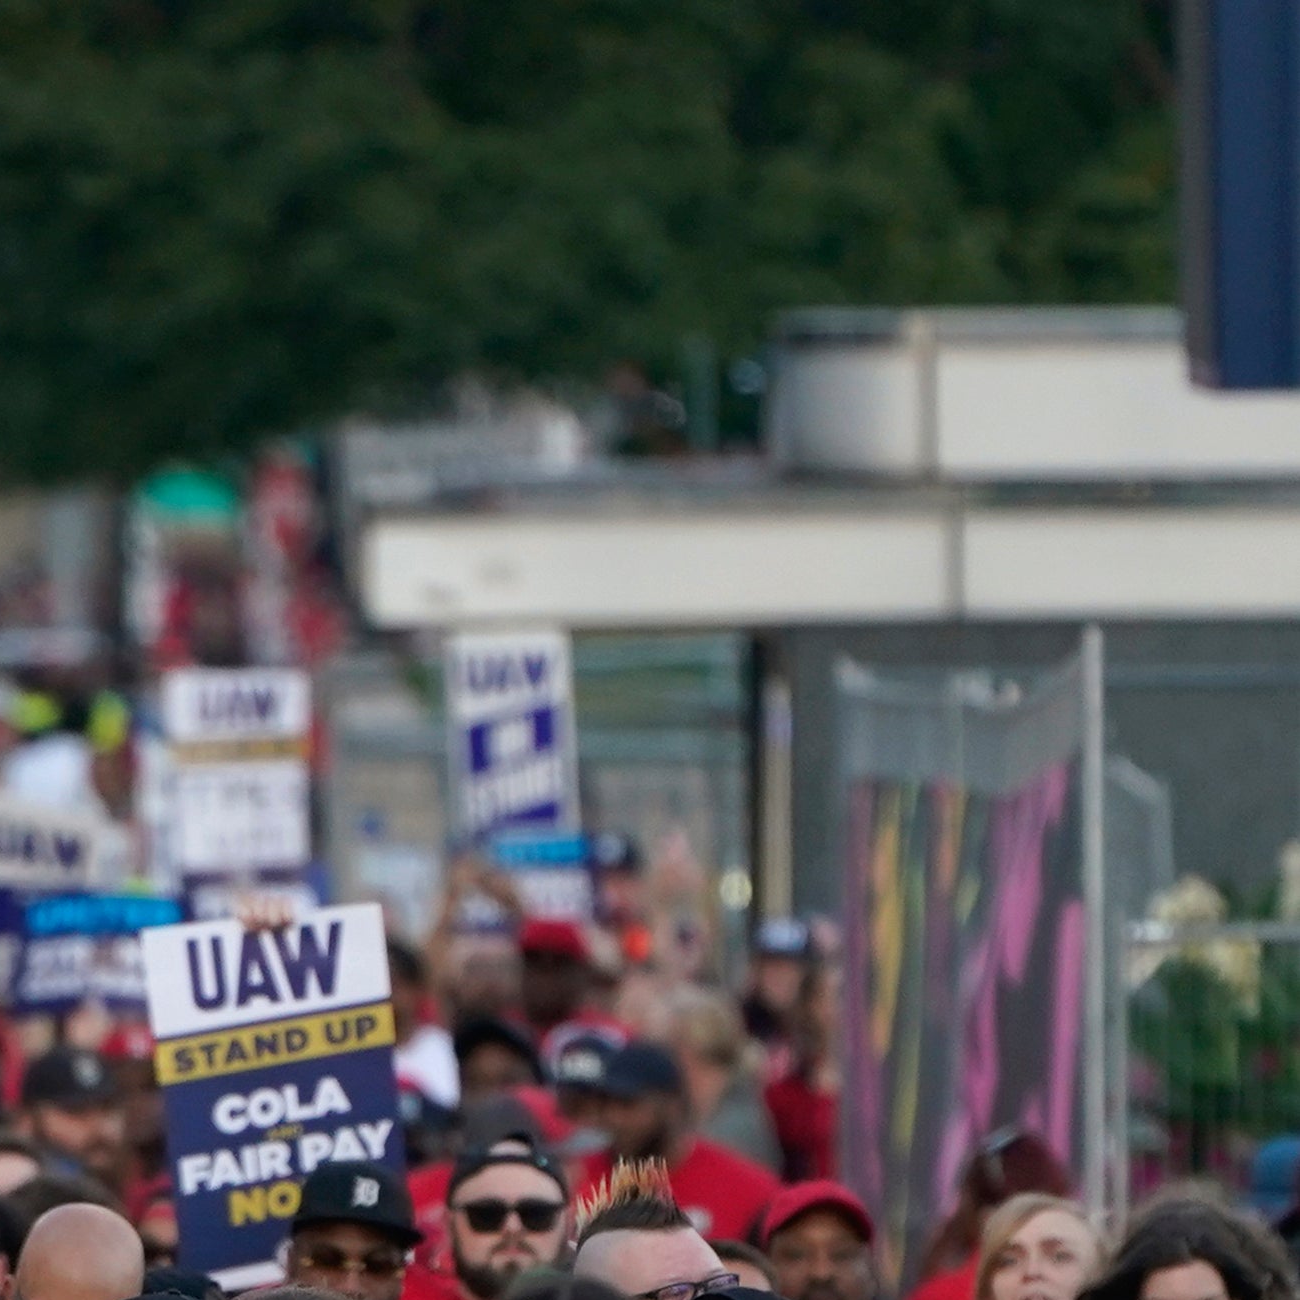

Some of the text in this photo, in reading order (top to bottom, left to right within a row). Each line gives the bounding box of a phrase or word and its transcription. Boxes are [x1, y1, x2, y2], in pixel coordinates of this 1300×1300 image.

[186, 921, 343, 1012] UAW
[174, 1014, 378, 1074] STAND UP
[212, 1075, 352, 1134] COLA
[178, 1118, 394, 1195] FAIR PAY
[228, 1181, 302, 1228] NO
